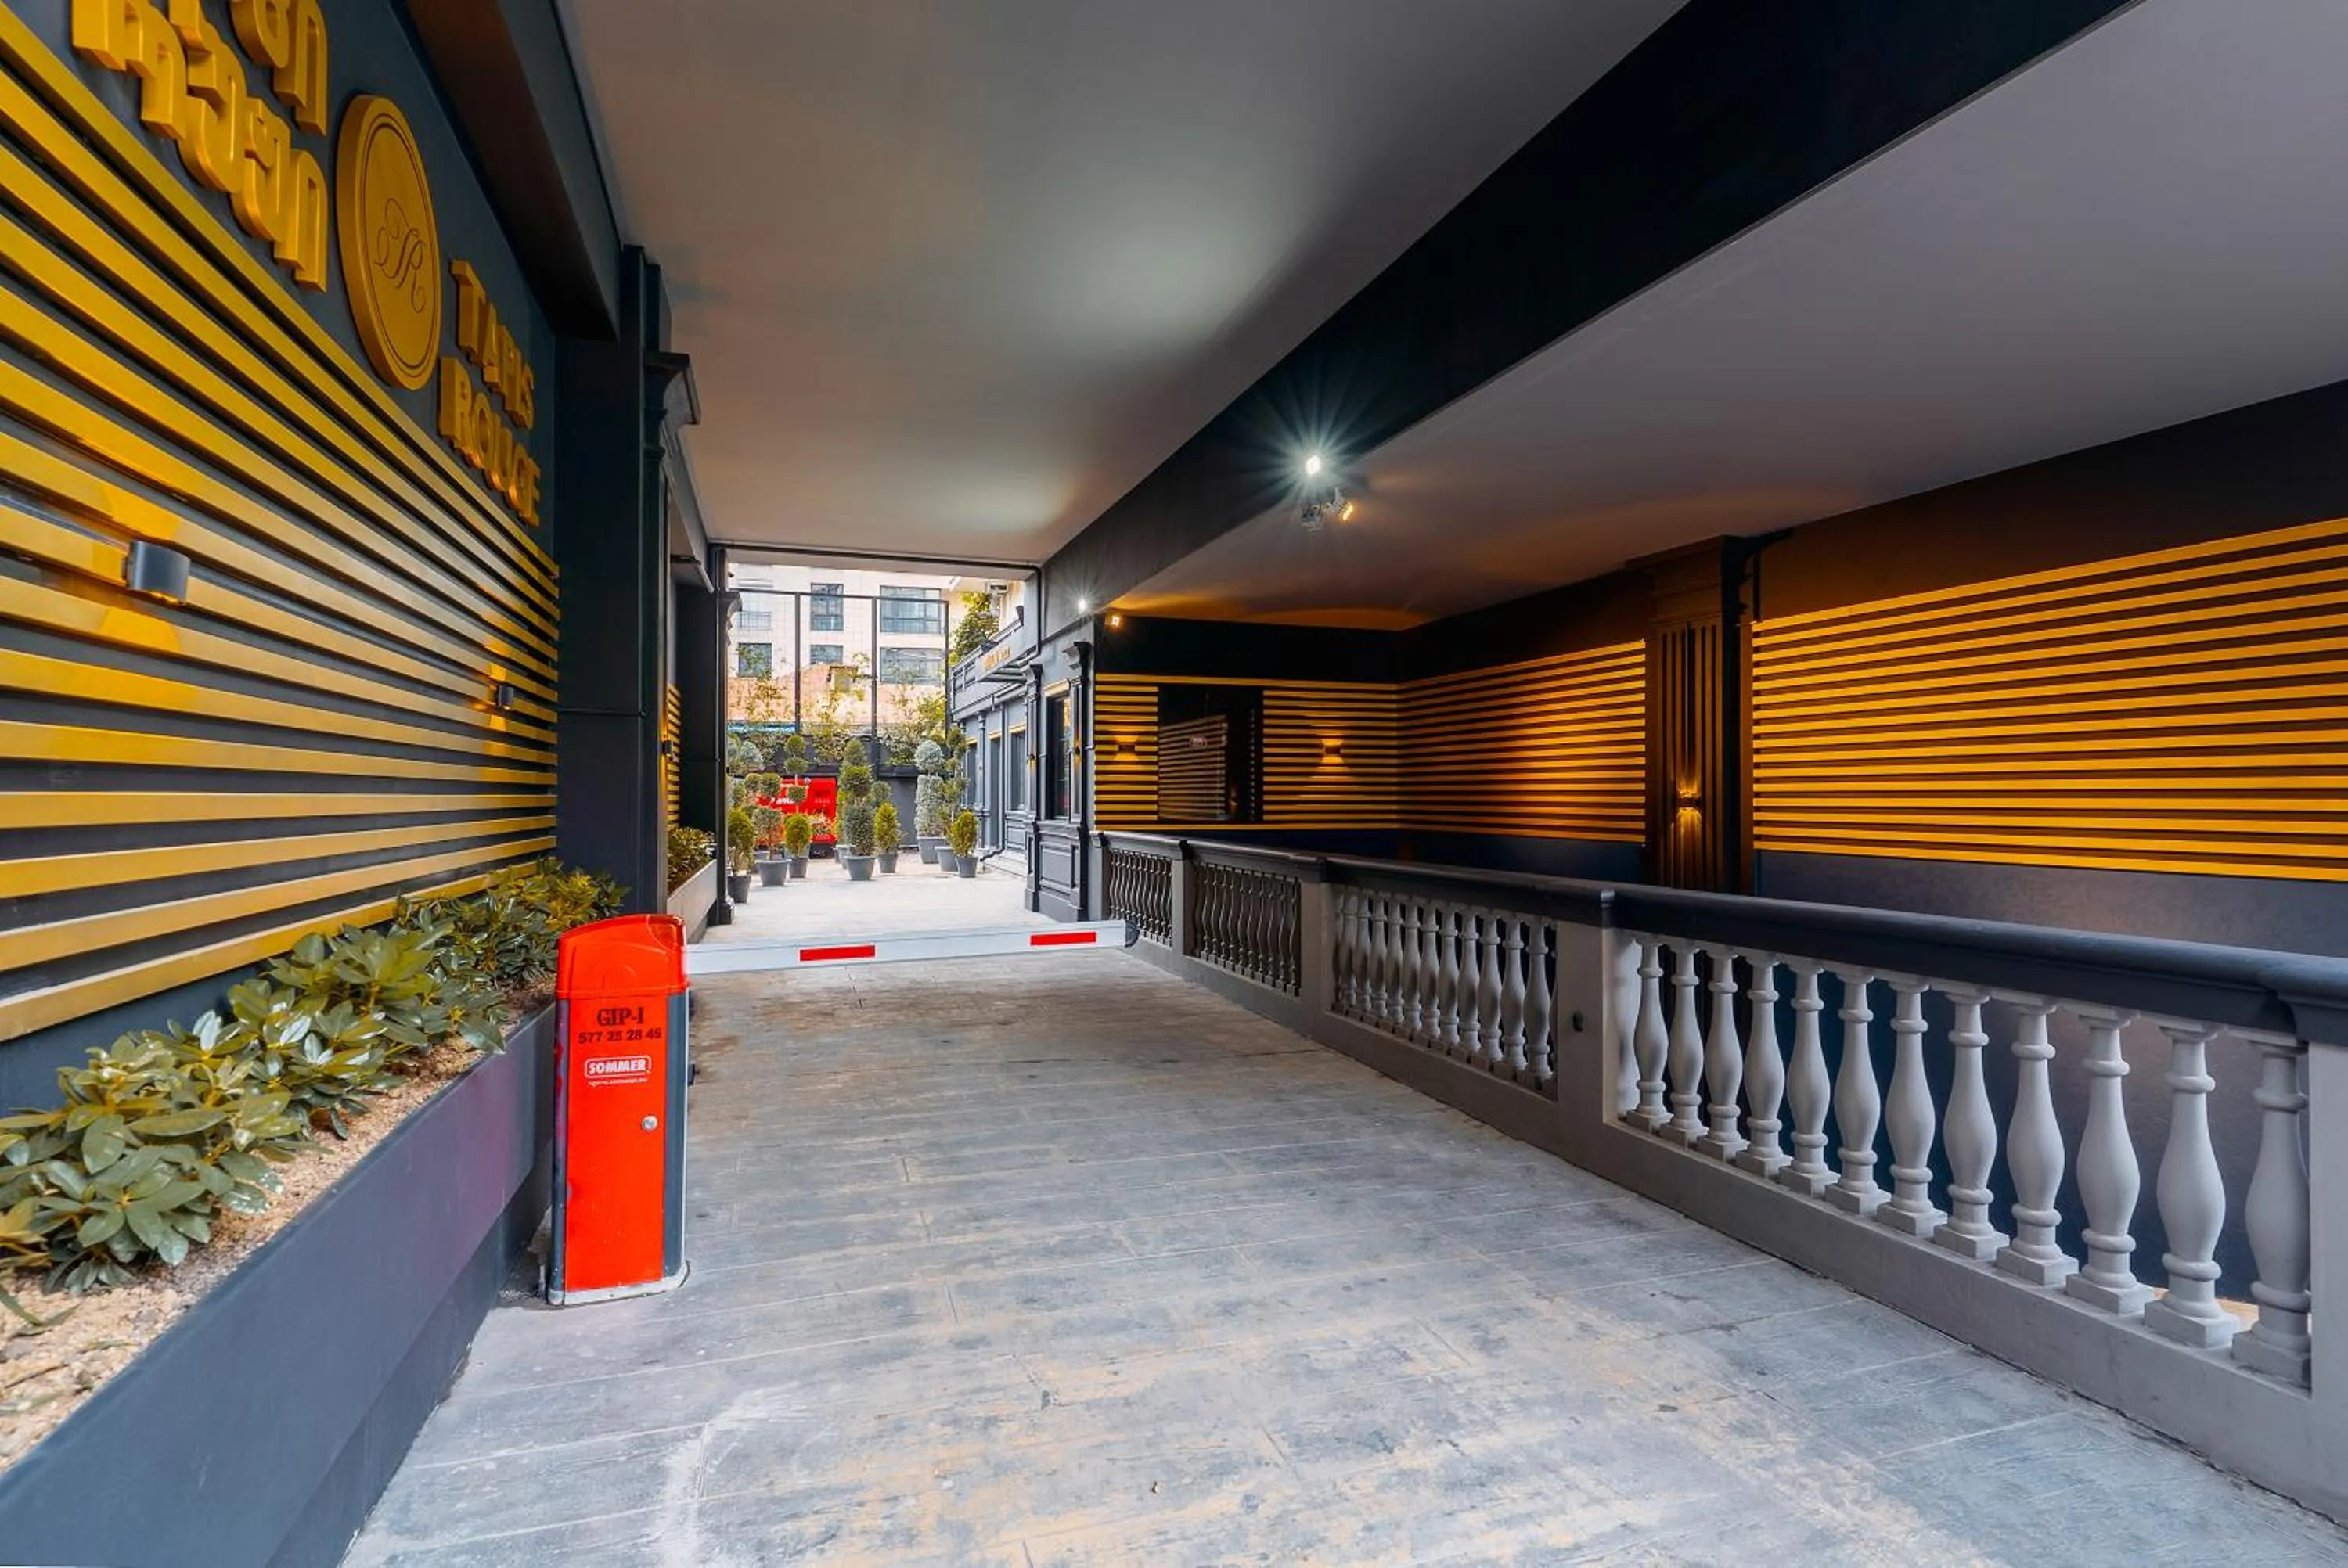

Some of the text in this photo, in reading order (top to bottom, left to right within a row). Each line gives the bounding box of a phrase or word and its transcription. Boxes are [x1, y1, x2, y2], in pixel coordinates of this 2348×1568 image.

[449, 259, 535, 430] TAPIS
[438, 356, 540, 527] ROUGE
[578, 1031, 603, 1045] 577
[588, 1059, 646, 1074] SOMMER
